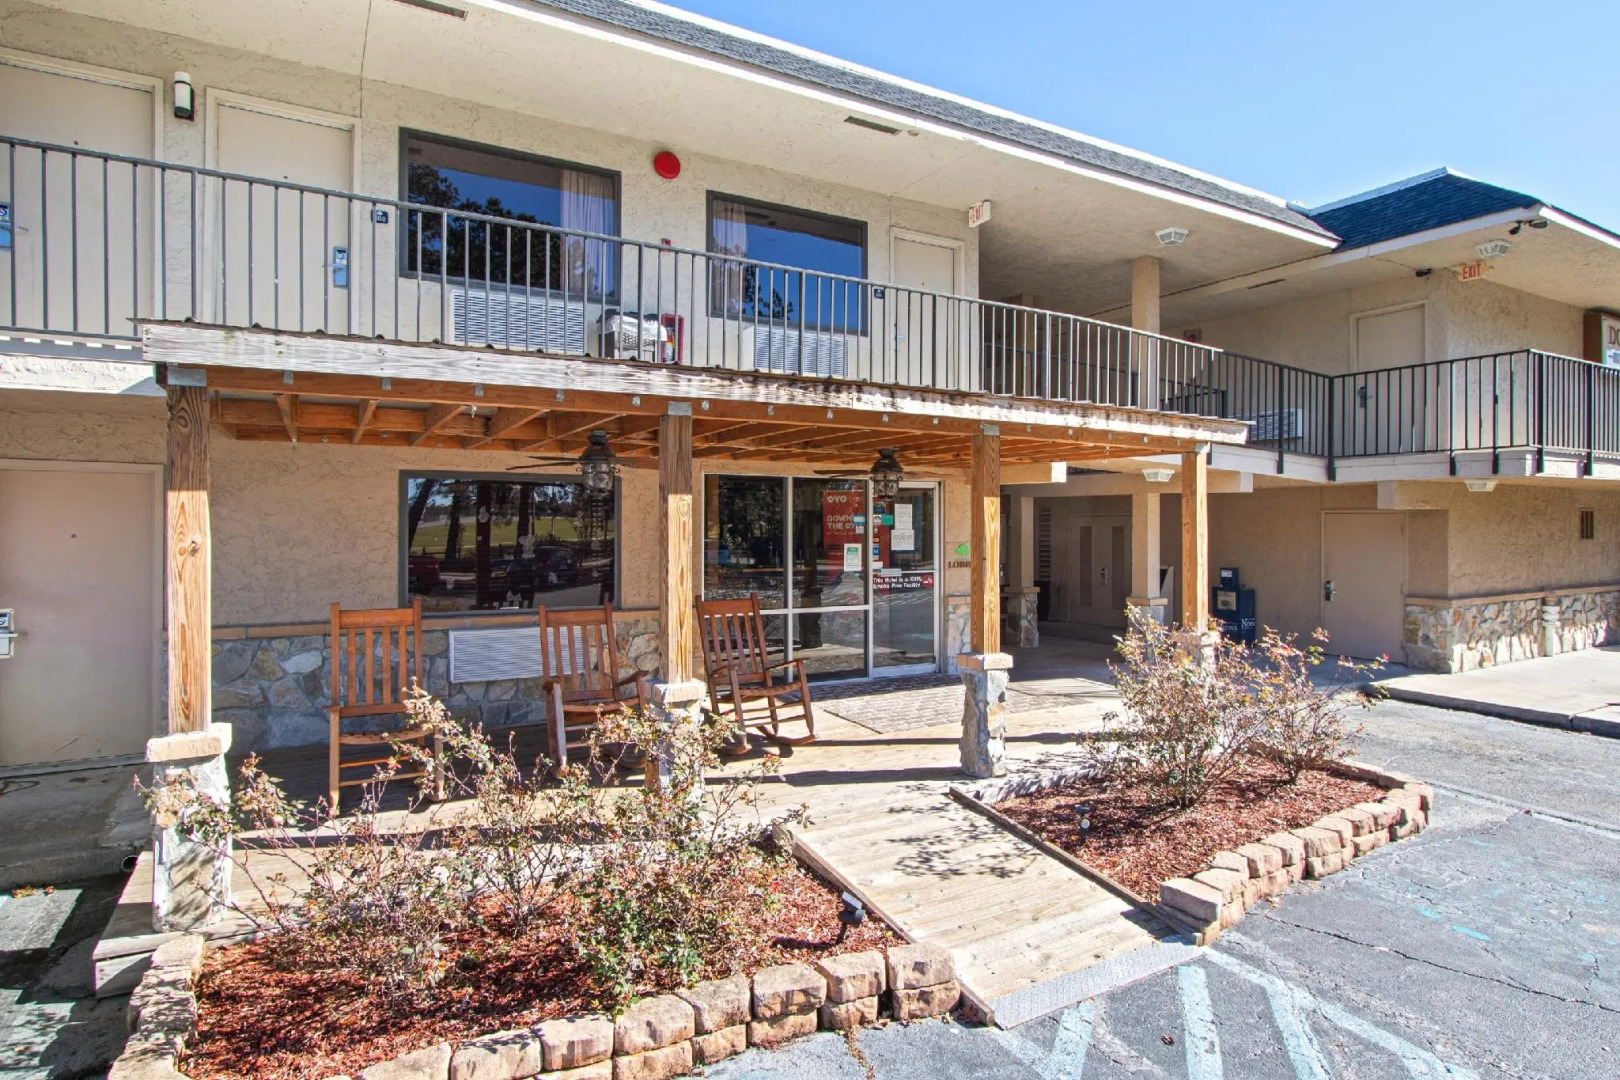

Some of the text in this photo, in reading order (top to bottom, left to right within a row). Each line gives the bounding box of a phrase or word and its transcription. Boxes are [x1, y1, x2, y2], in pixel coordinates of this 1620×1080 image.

[1462, 263, 1481, 280] EXIT
[827, 495, 848, 503] OYO
[827, 514, 853, 522] DOWN
[827, 522, 844, 530] THE
